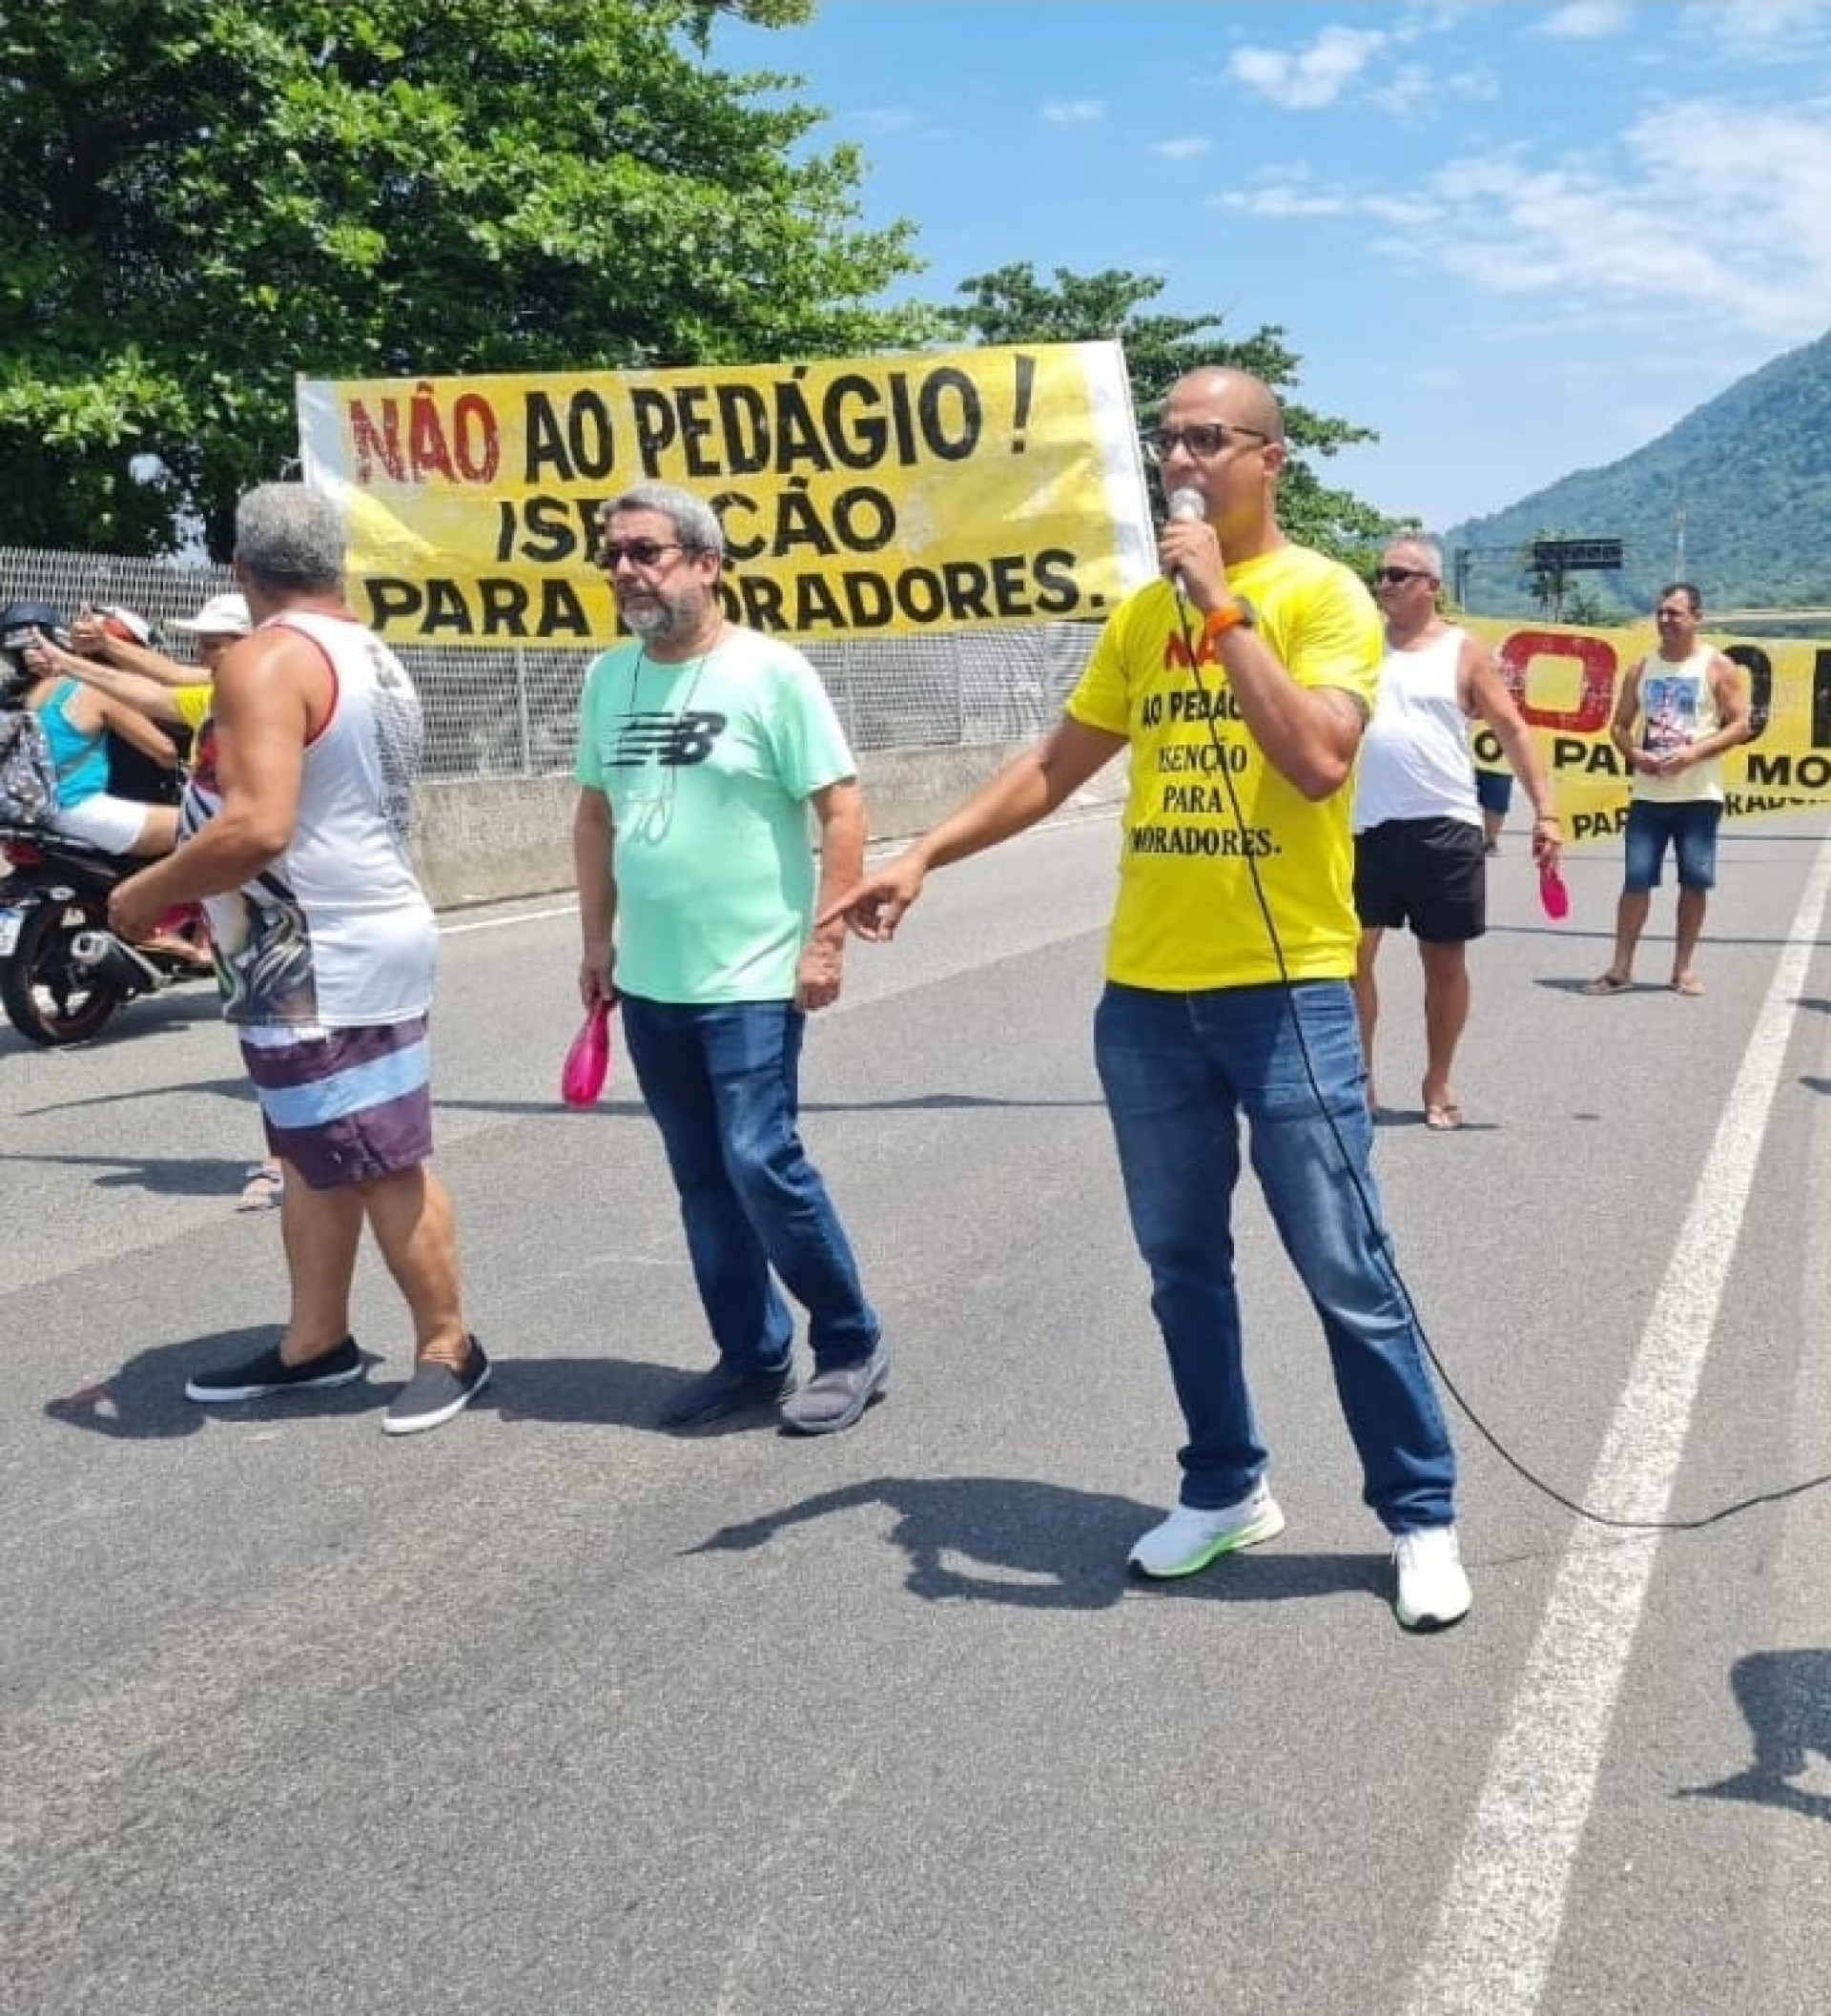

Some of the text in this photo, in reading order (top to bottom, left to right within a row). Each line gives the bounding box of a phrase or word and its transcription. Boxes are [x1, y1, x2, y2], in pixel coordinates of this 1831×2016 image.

[349, 381, 500, 483] NÃO
[524, 388, 613, 482] AO
[629, 366, 982, 479] PEDÁGIO
[495, 477, 896, 570] ISEÇÃO
[364, 578, 590, 636] PARA
[1163, 785, 1224, 813] PARA
